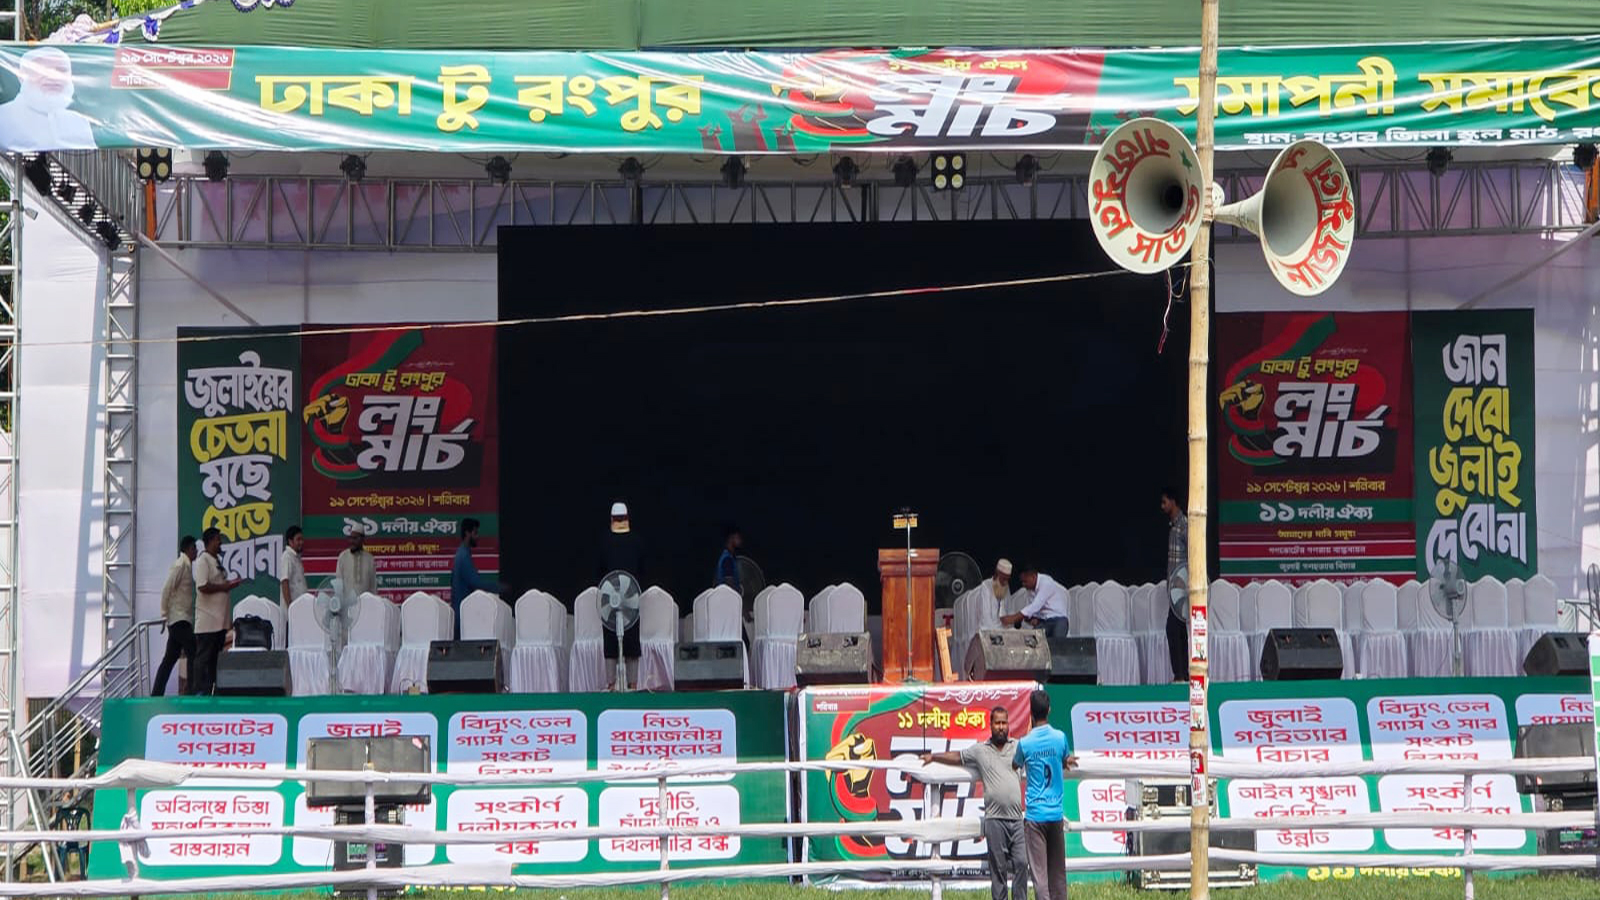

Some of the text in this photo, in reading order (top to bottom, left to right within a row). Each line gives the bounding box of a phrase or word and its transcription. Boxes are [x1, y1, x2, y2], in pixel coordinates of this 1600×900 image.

[255, 64, 705, 133] ঢাকা টু রংপুর
[1173, 56, 1600, 122] সমাপনী সমাবে
[1385, 127, 1450, 142] জিলা
[1457, 128, 1503, 146] স্কুল
[1260, 357, 1359, 379] ঢাকা টু রংপুর
[1442, 334, 1508, 387] জান
[184, 350, 293, 417] জুলাইয়ের
[345, 369, 446, 392] ঢাকা টু রংপুর
[1274, 382, 1356, 421] লং
[358, 395, 441, 434] লং
[1443, 387, 1510, 444] দেবো
[190, 410, 287, 463] চেতনা
[1272, 404, 1391, 458] মার্চ
[356, 418, 474, 471] মার্চ
[199, 454, 273, 509] মুছে
[1429, 432, 1522, 516] জুলাই
[1263, 479, 1310, 495] সেপ্টেম্বর
[1311, 481, 1341, 492] ২০২৬
[1349, 477, 1386, 492] শনিবার
[347, 493, 394, 509] সেপ্টেম্বর
[396, 495, 425, 506] ২০২৬
[433, 491, 471, 506] শনিবার
[1259, 502, 1373, 522] ১১ দলীয় ঐক্য
[202, 502, 273, 542] যেতে
[381, 518, 418, 534] দলীয়
[420, 518, 458, 534] ঐক্য
[1425, 503, 1528, 577] দেবোনা
[643, 712, 690, 729] নিত্য
[897, 707, 986, 729] ১১ দলীয় ঐক্য
[1247, 705, 1323, 729] জুলাই
[1376, 717, 1498, 731] গ্যাস ও সার
[161, 719, 274, 737] গণভোটের
[326, 719, 403, 737] জলাই
[610, 726, 723, 743] প্রয়োজনীয়
[1104, 729, 1181, 745] গণরায়
[1234, 728, 1348, 744] গণহত্যার
[178, 741, 256, 756] গণরায়
[456, 732, 577, 747] গ্যাস ও সার
[1405, 733, 1474, 747] সংকট
[481, 747, 551, 763] সংকট
[610, 743, 723, 760] দ্রব্যমূল্যের
[1256, 745, 1330, 763] বিচার
[1238, 783, 1294, 800] আইন
[155, 795, 270, 815] অবিলম্বে তিস্তা
[475, 795, 564, 814] সংকীর্ণ
[169, 842, 250, 857] বাস্তবায়ন
[697, 835, 729, 852] বন্ধ
